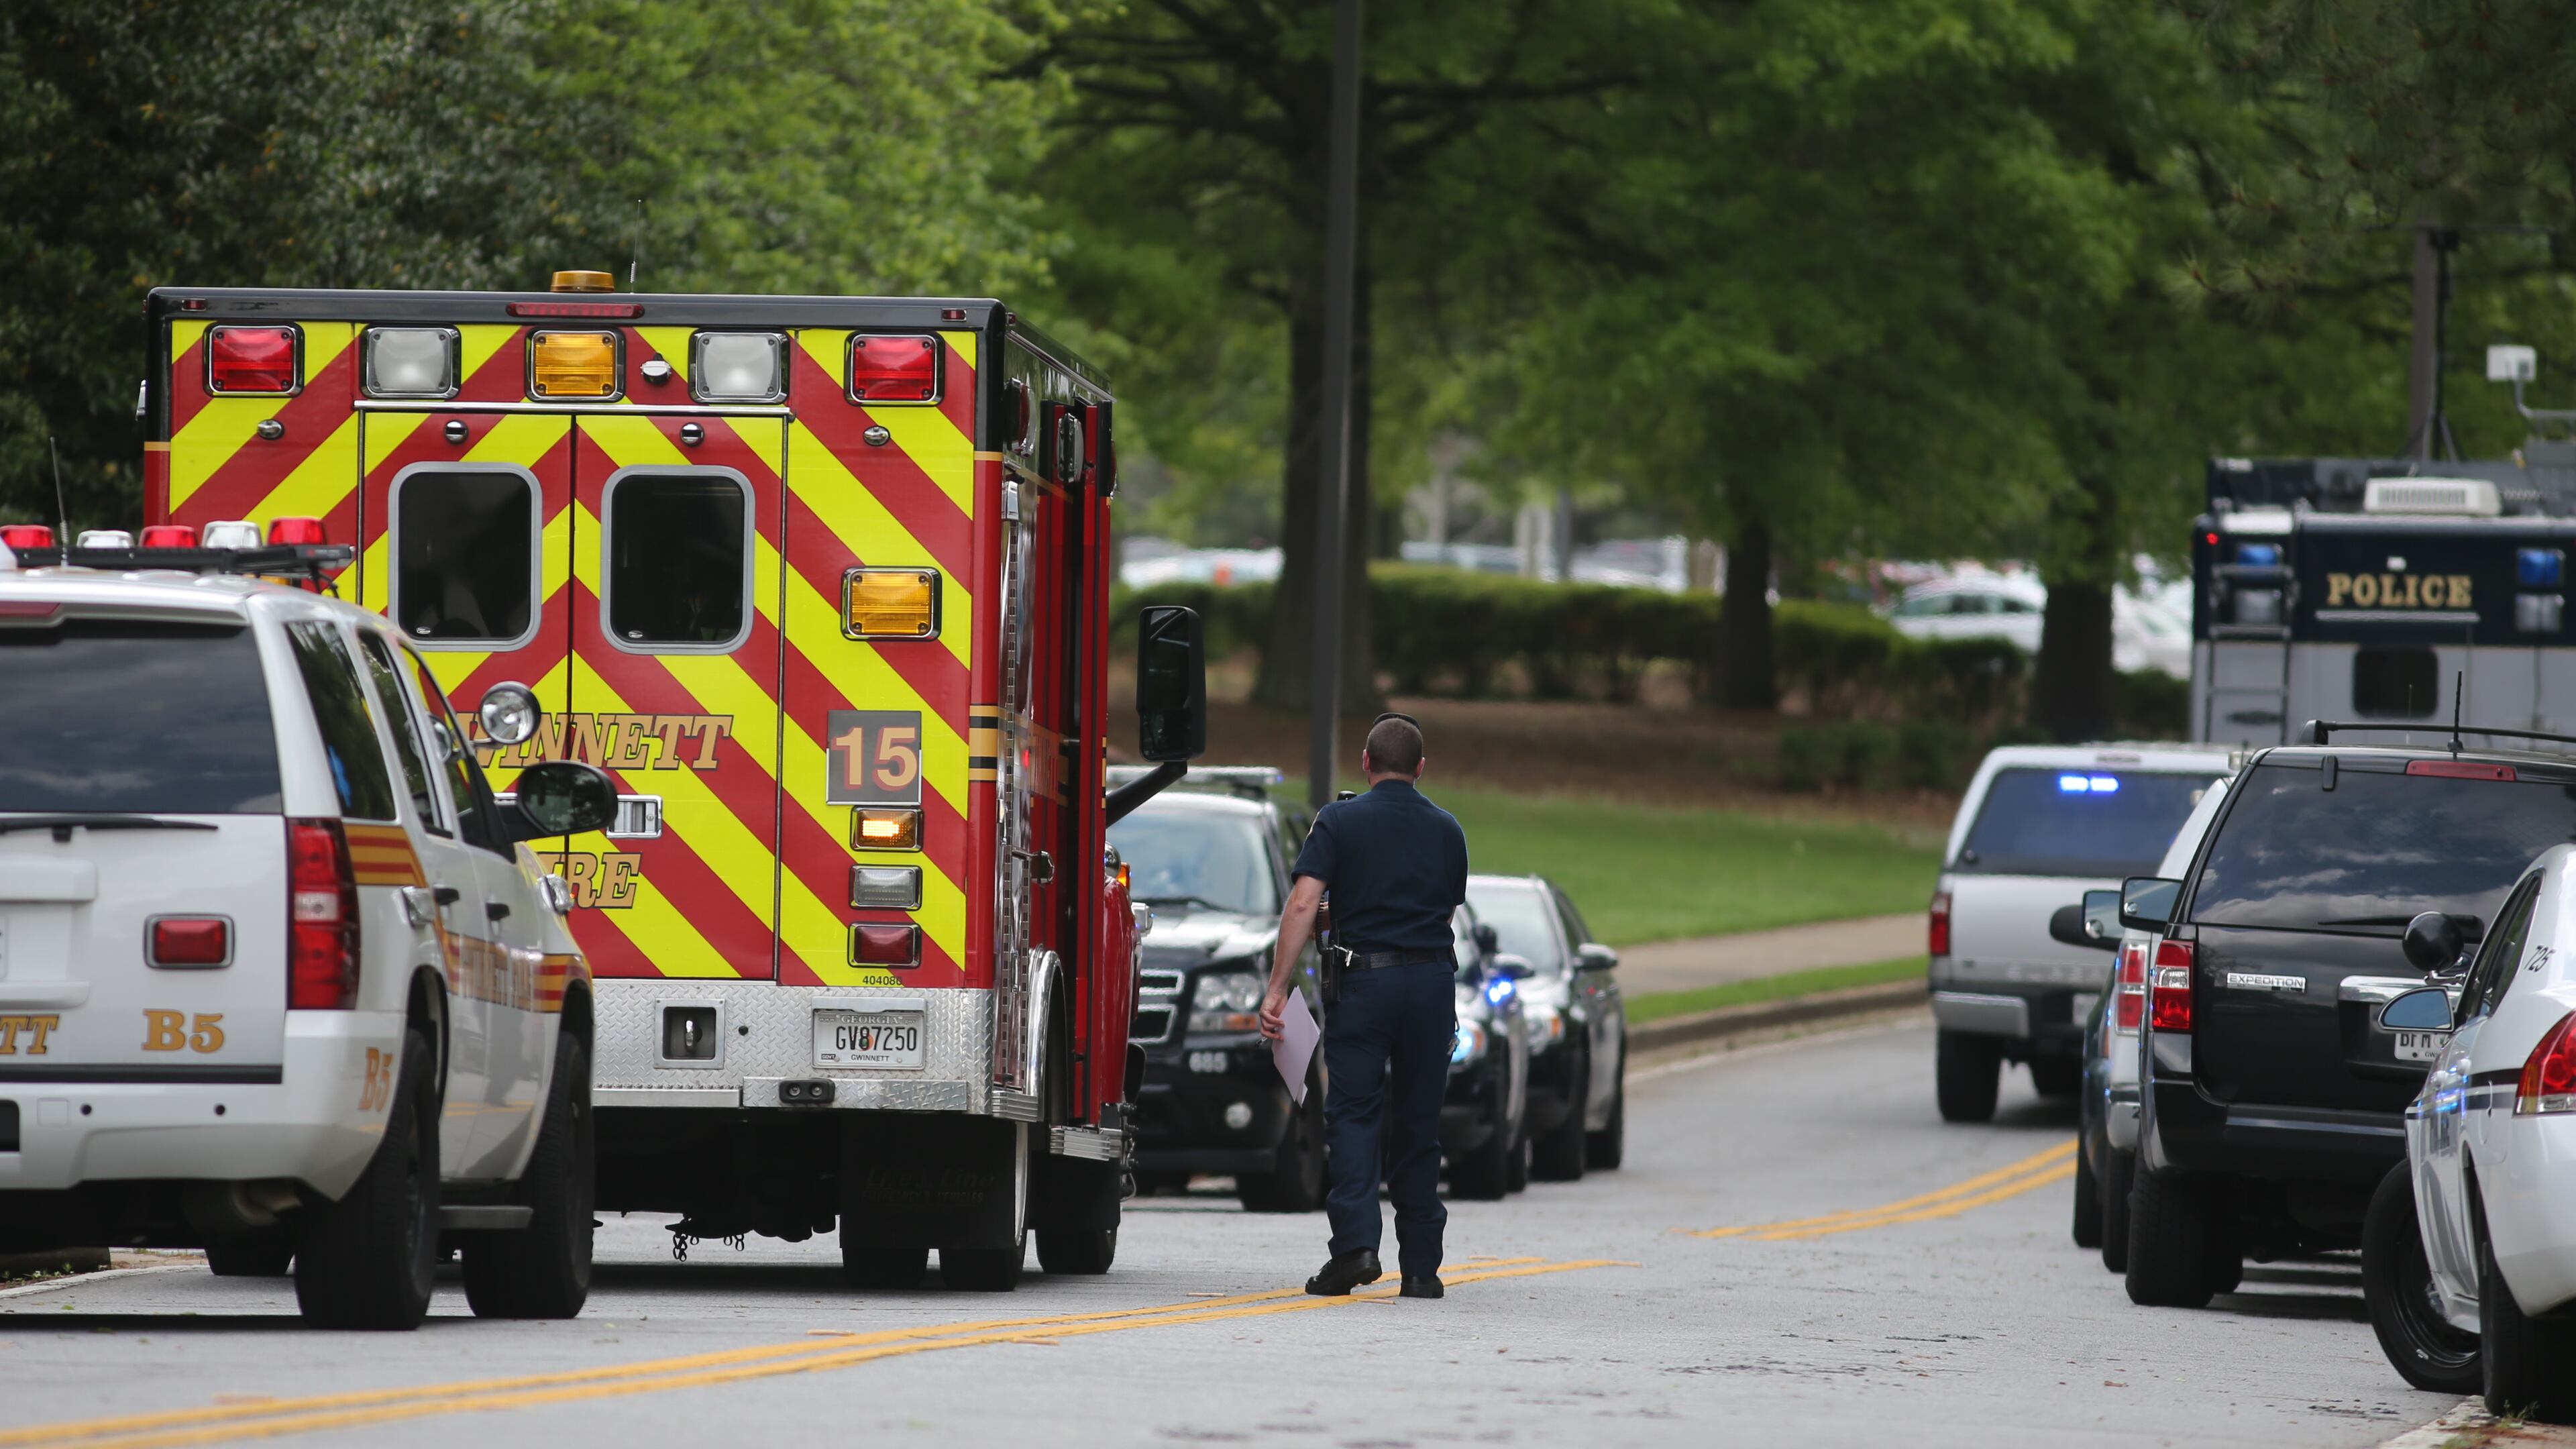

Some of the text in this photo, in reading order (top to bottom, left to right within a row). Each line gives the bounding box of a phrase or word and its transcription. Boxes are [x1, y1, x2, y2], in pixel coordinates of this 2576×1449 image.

[2328, 573, 2472, 608] POLICE
[833, 727, 918, 792] 15
[2523, 945, 2557, 973] 725
[863, 975, 902, 985] 404080
[2229, 974, 2304, 987] EXPEDITION
[142, 1008, 225, 1054] B5
[841, 1015, 900, 1024] GEORGIA
[836, 1026, 917, 1051] GV87250
[851, 1054, 890, 1062] GWINNETT
[358, 1047, 393, 1112] B5
